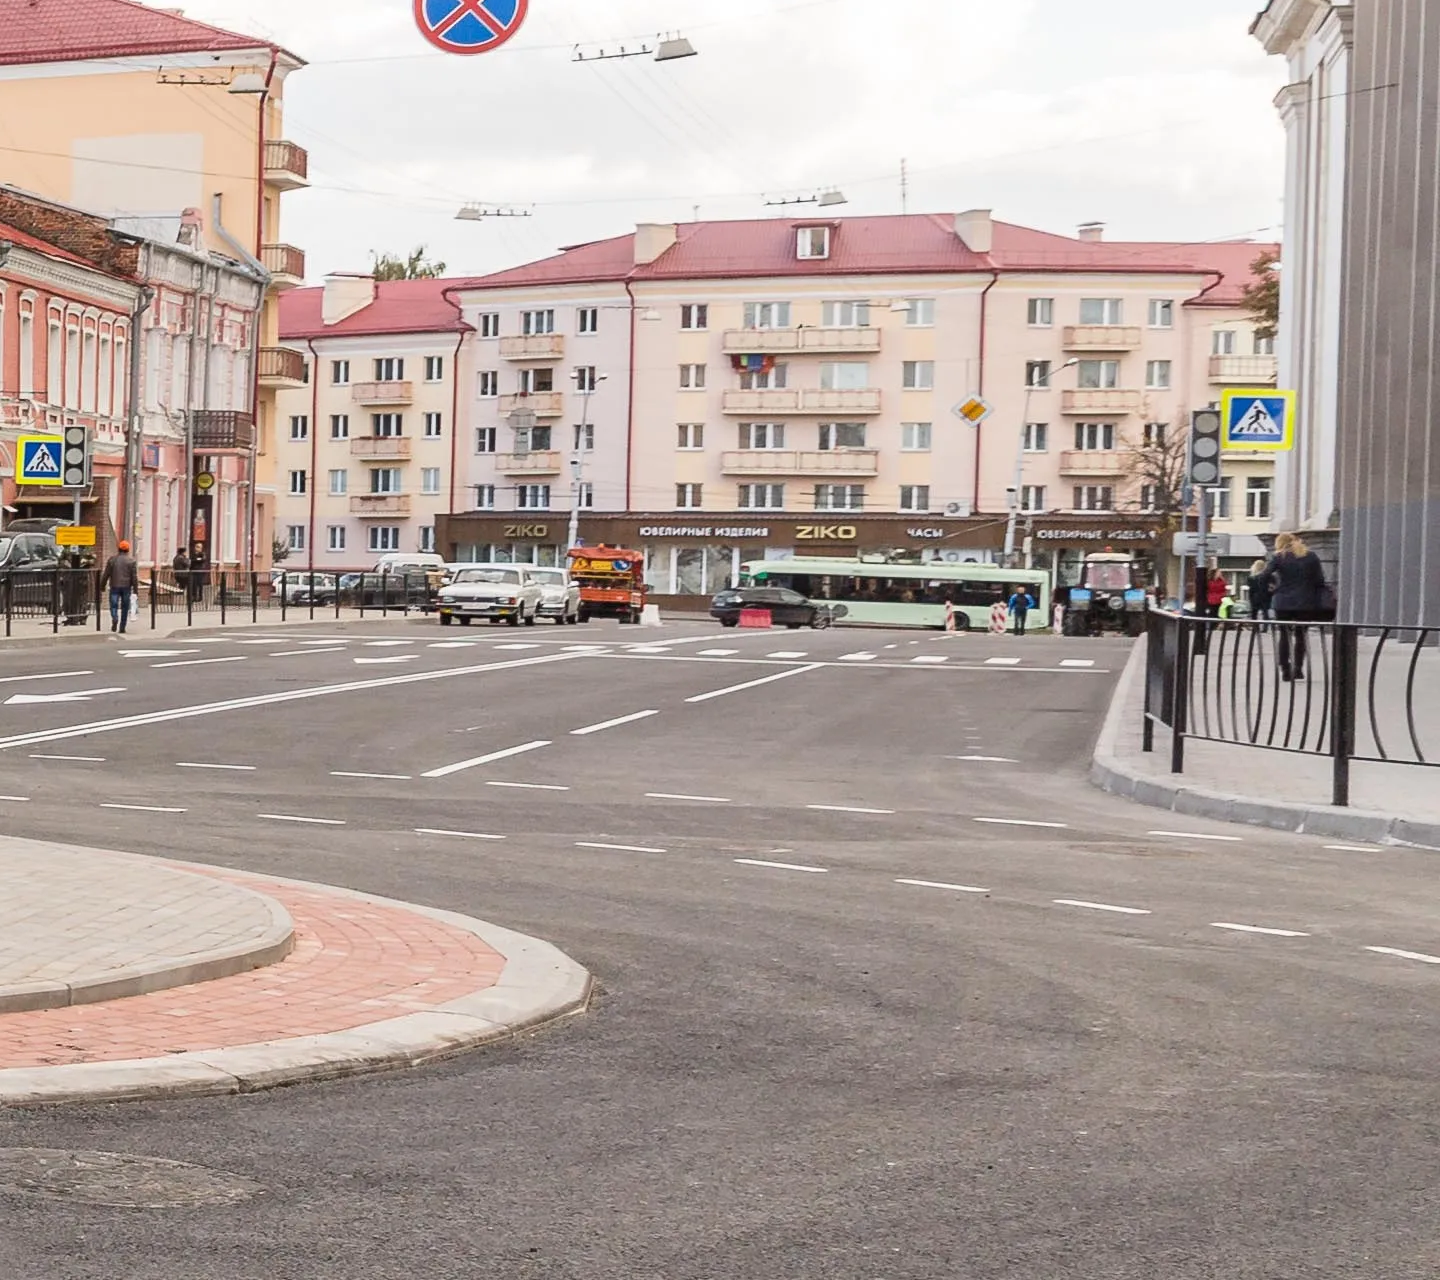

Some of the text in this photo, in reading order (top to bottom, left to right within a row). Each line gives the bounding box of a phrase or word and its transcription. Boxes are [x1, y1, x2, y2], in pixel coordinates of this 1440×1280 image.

[503, 524, 548, 537] ZIKO
[639, 526, 769, 537] ЮВЕЛИРНЫЕ ИЗДЕЛИЯ
[795, 525, 857, 539] ZIKO
[906, 528, 943, 538] ЧАСЫ
